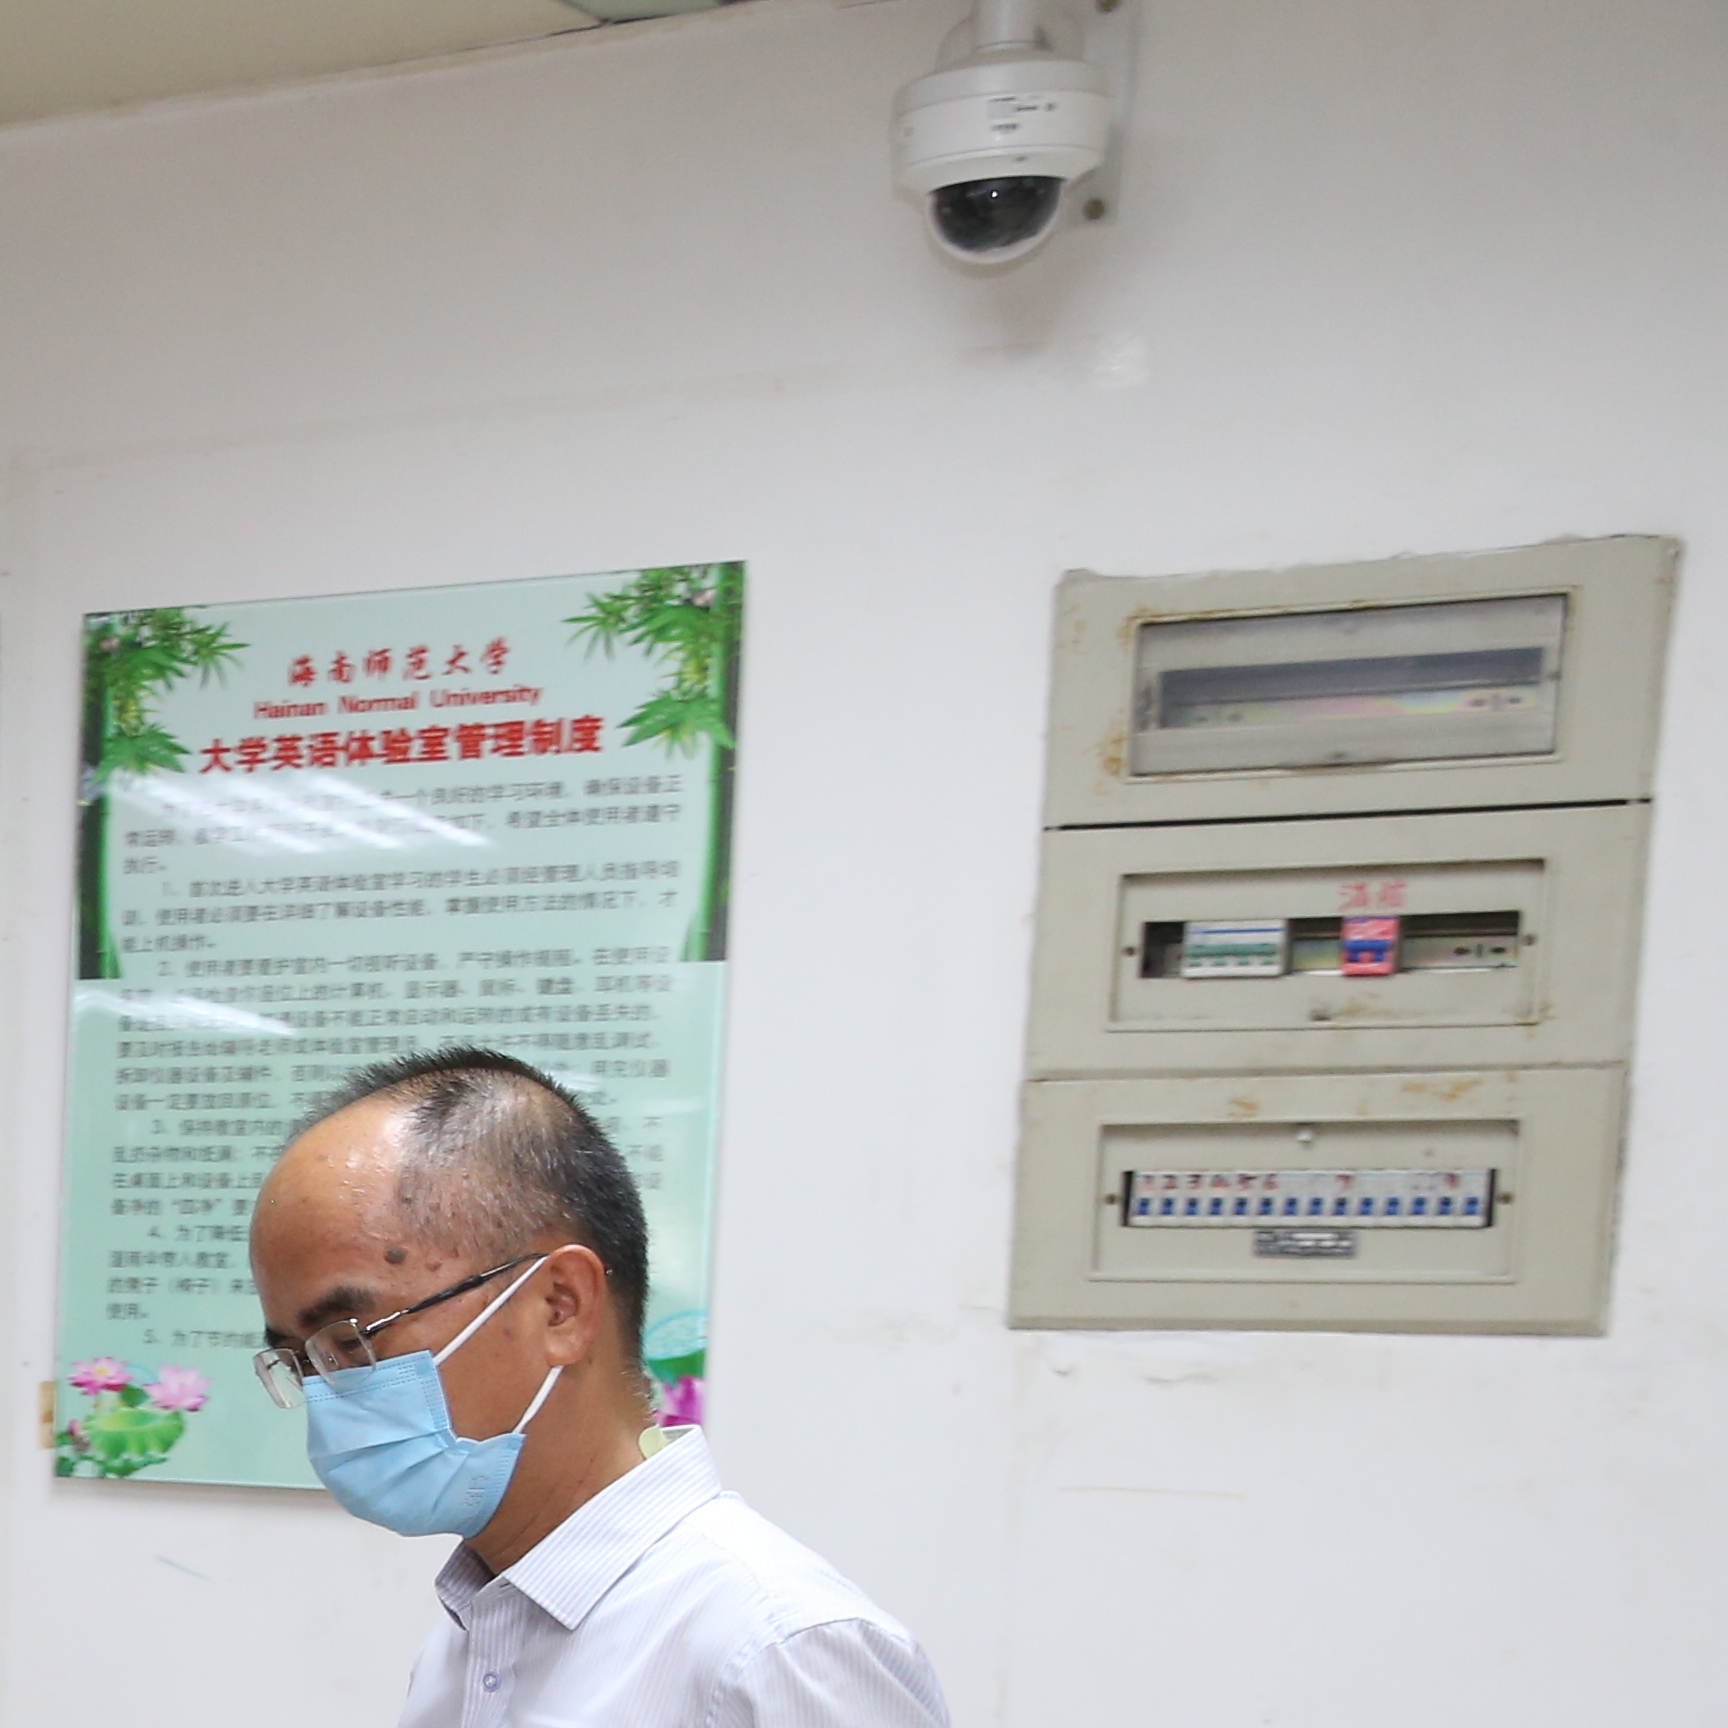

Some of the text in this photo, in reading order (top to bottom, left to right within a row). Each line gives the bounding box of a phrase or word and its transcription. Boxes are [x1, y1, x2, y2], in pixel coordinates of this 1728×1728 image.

[287, 638, 513, 687] 海南师范大学
[253, 682, 544, 721] Hainan Normal University
[199, 714, 605, 777] 大学英语体验室管理制度
